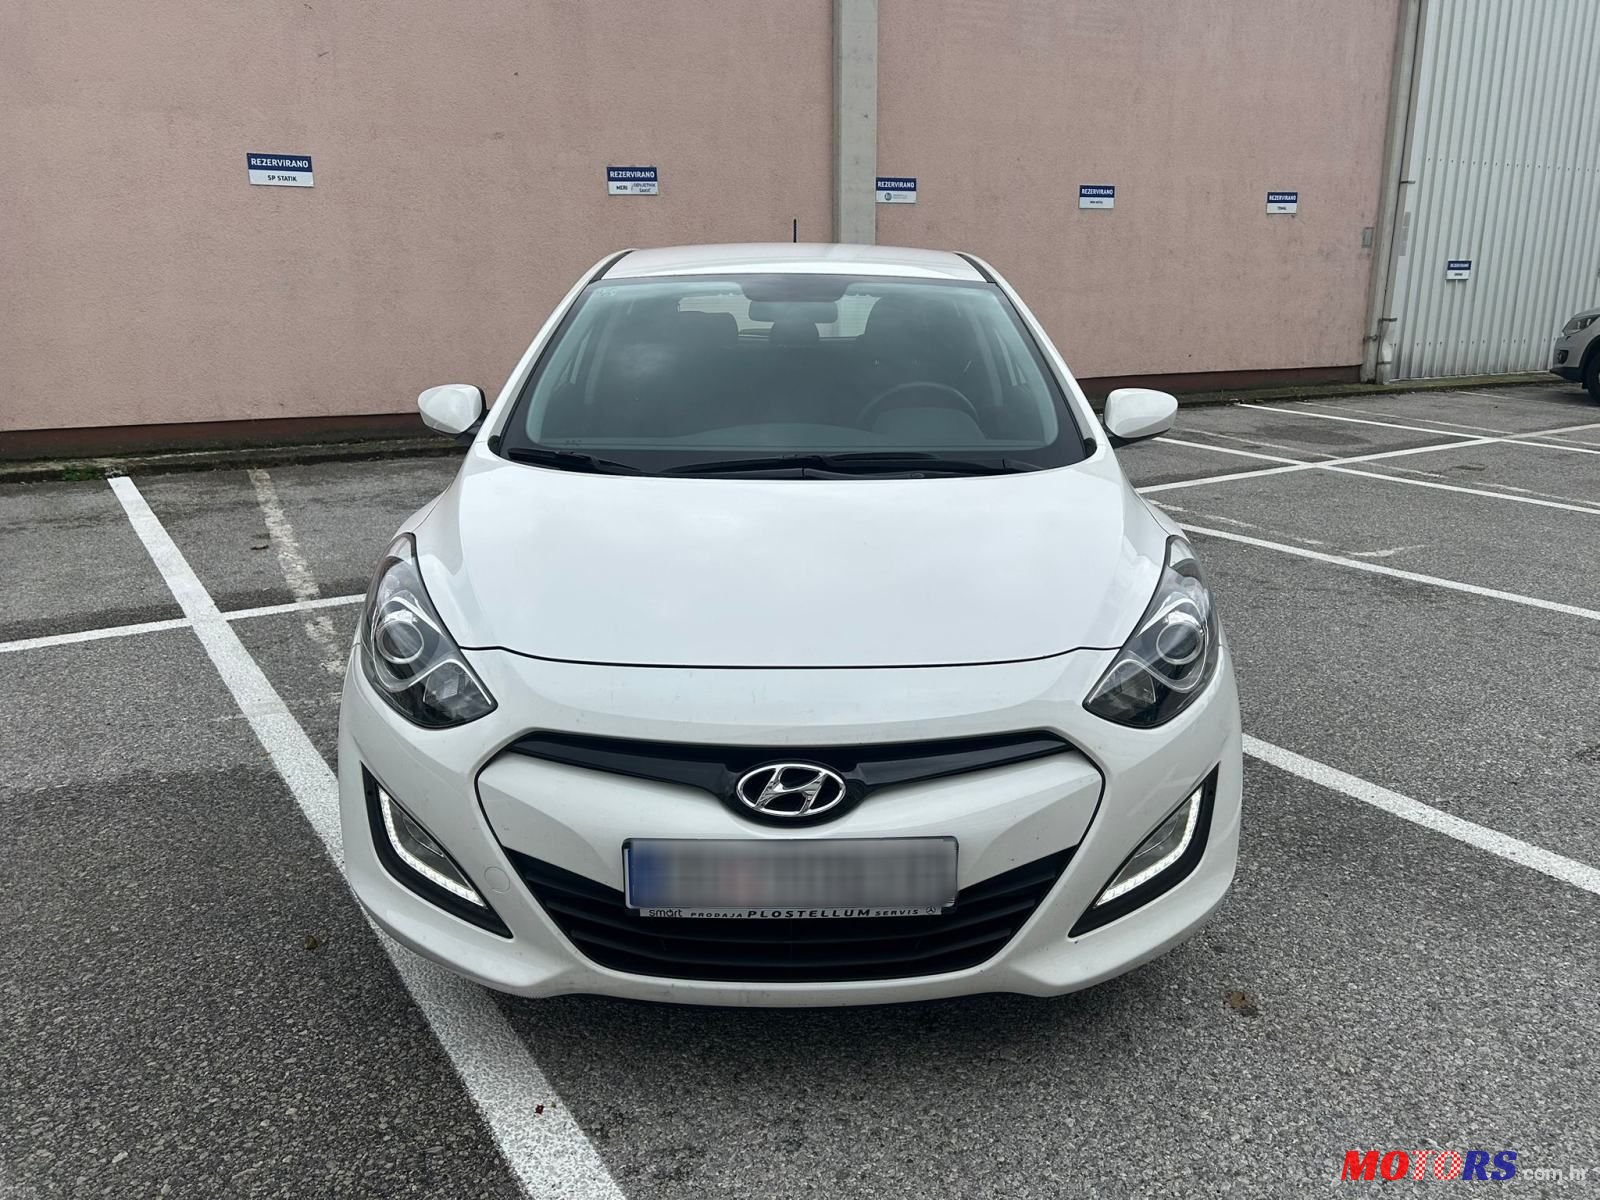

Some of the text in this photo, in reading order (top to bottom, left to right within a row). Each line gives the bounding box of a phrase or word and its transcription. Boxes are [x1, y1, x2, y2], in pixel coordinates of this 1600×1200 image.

[250, 158, 309, 168] REZERVIRANO
[609, 170, 655, 178] REZERVIRANO
[648, 909, 683, 918] smart
[747, 908, 871, 919] PLOSTELLUM
[874, 908, 919, 916] SERVIS
